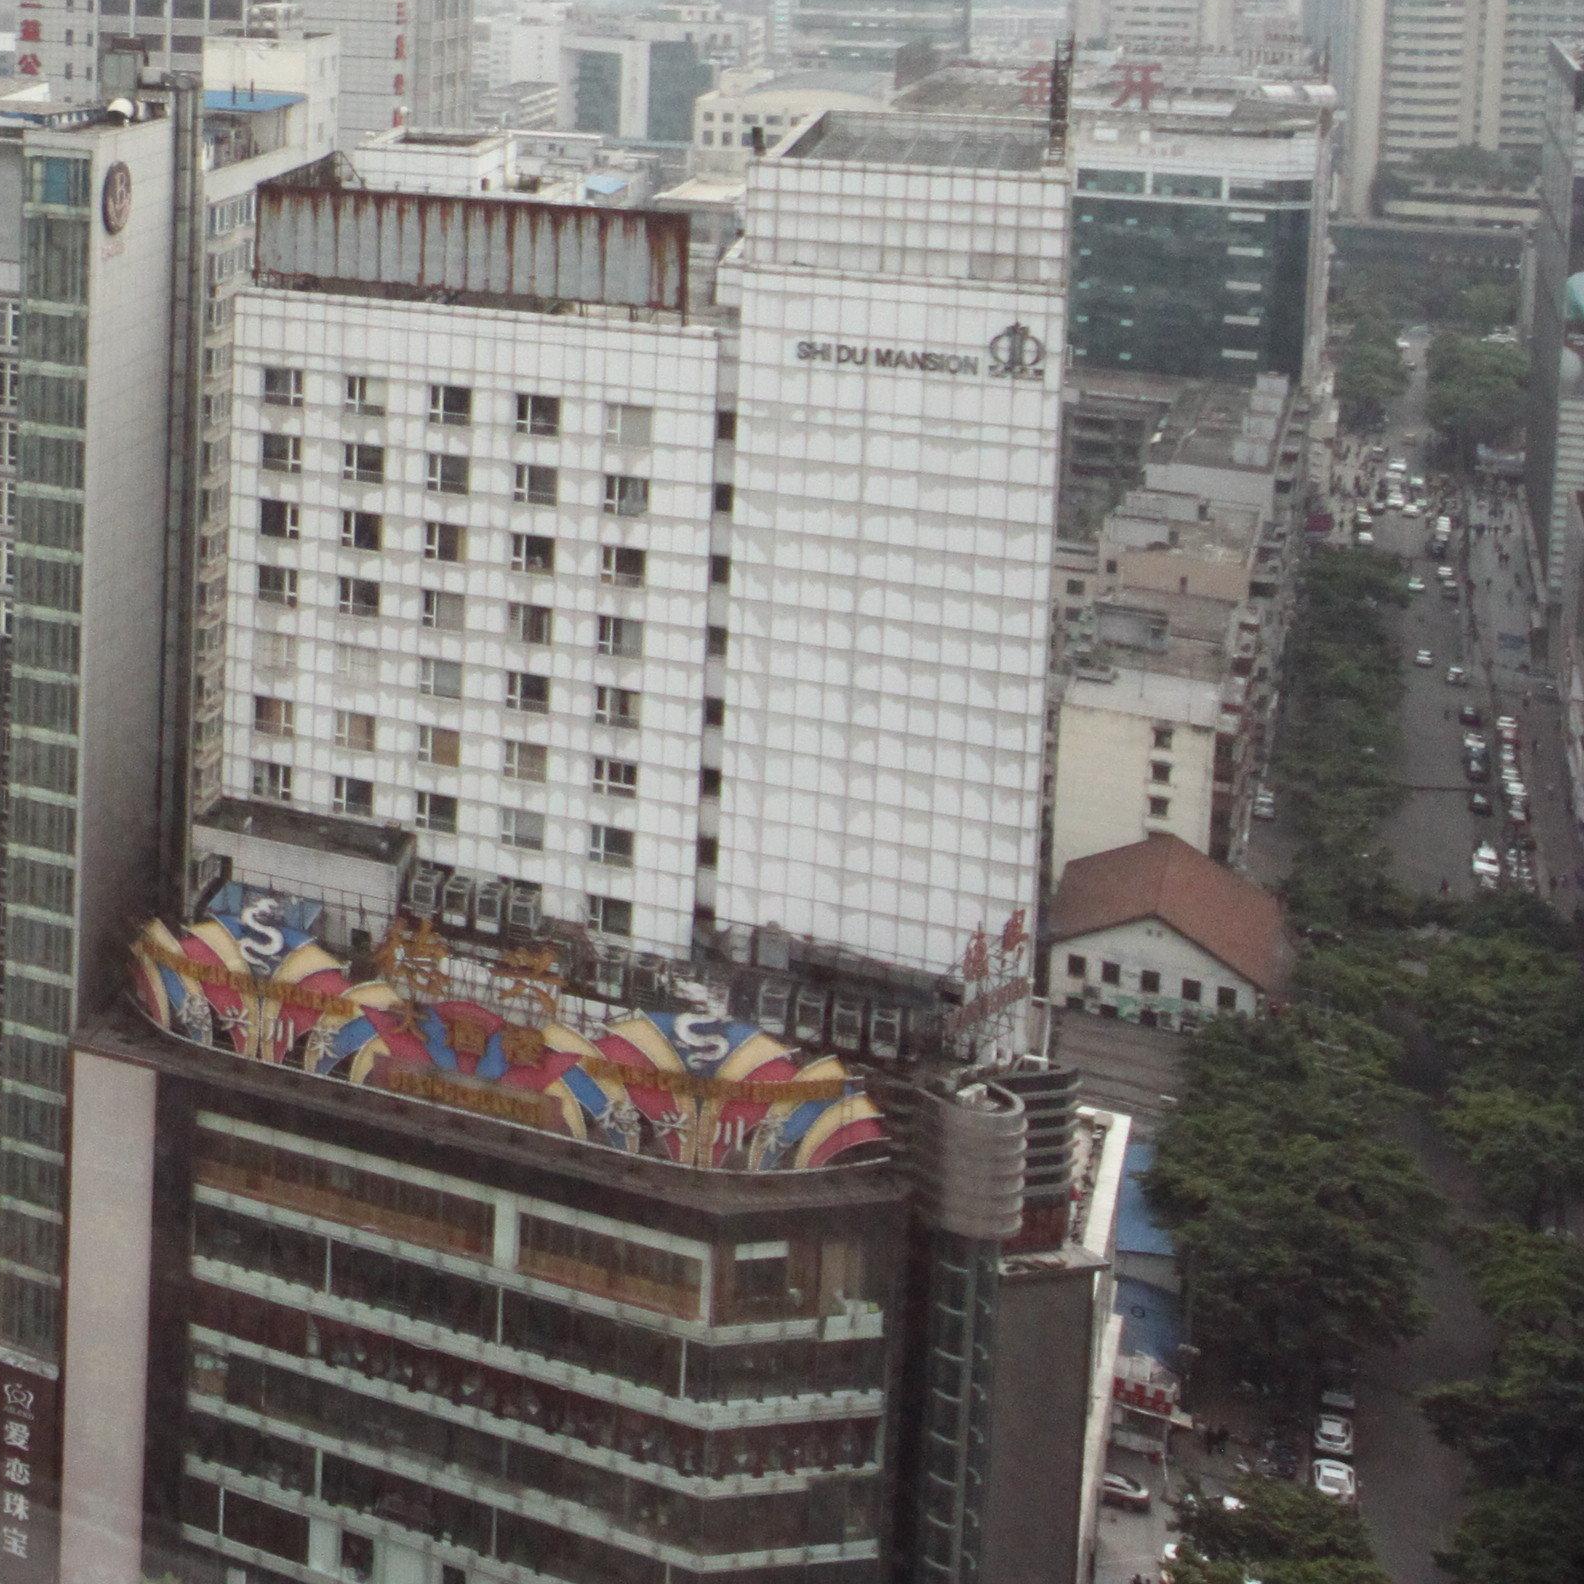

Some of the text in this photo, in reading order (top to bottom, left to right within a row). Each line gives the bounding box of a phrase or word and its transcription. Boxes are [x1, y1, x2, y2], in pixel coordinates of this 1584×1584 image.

[797, 341, 832, 363] SHI
[835, 343, 868, 366] DU
[875, 347, 979, 376] MANSION
[3, 1420, 31, 1559] 爱恋珠宝
